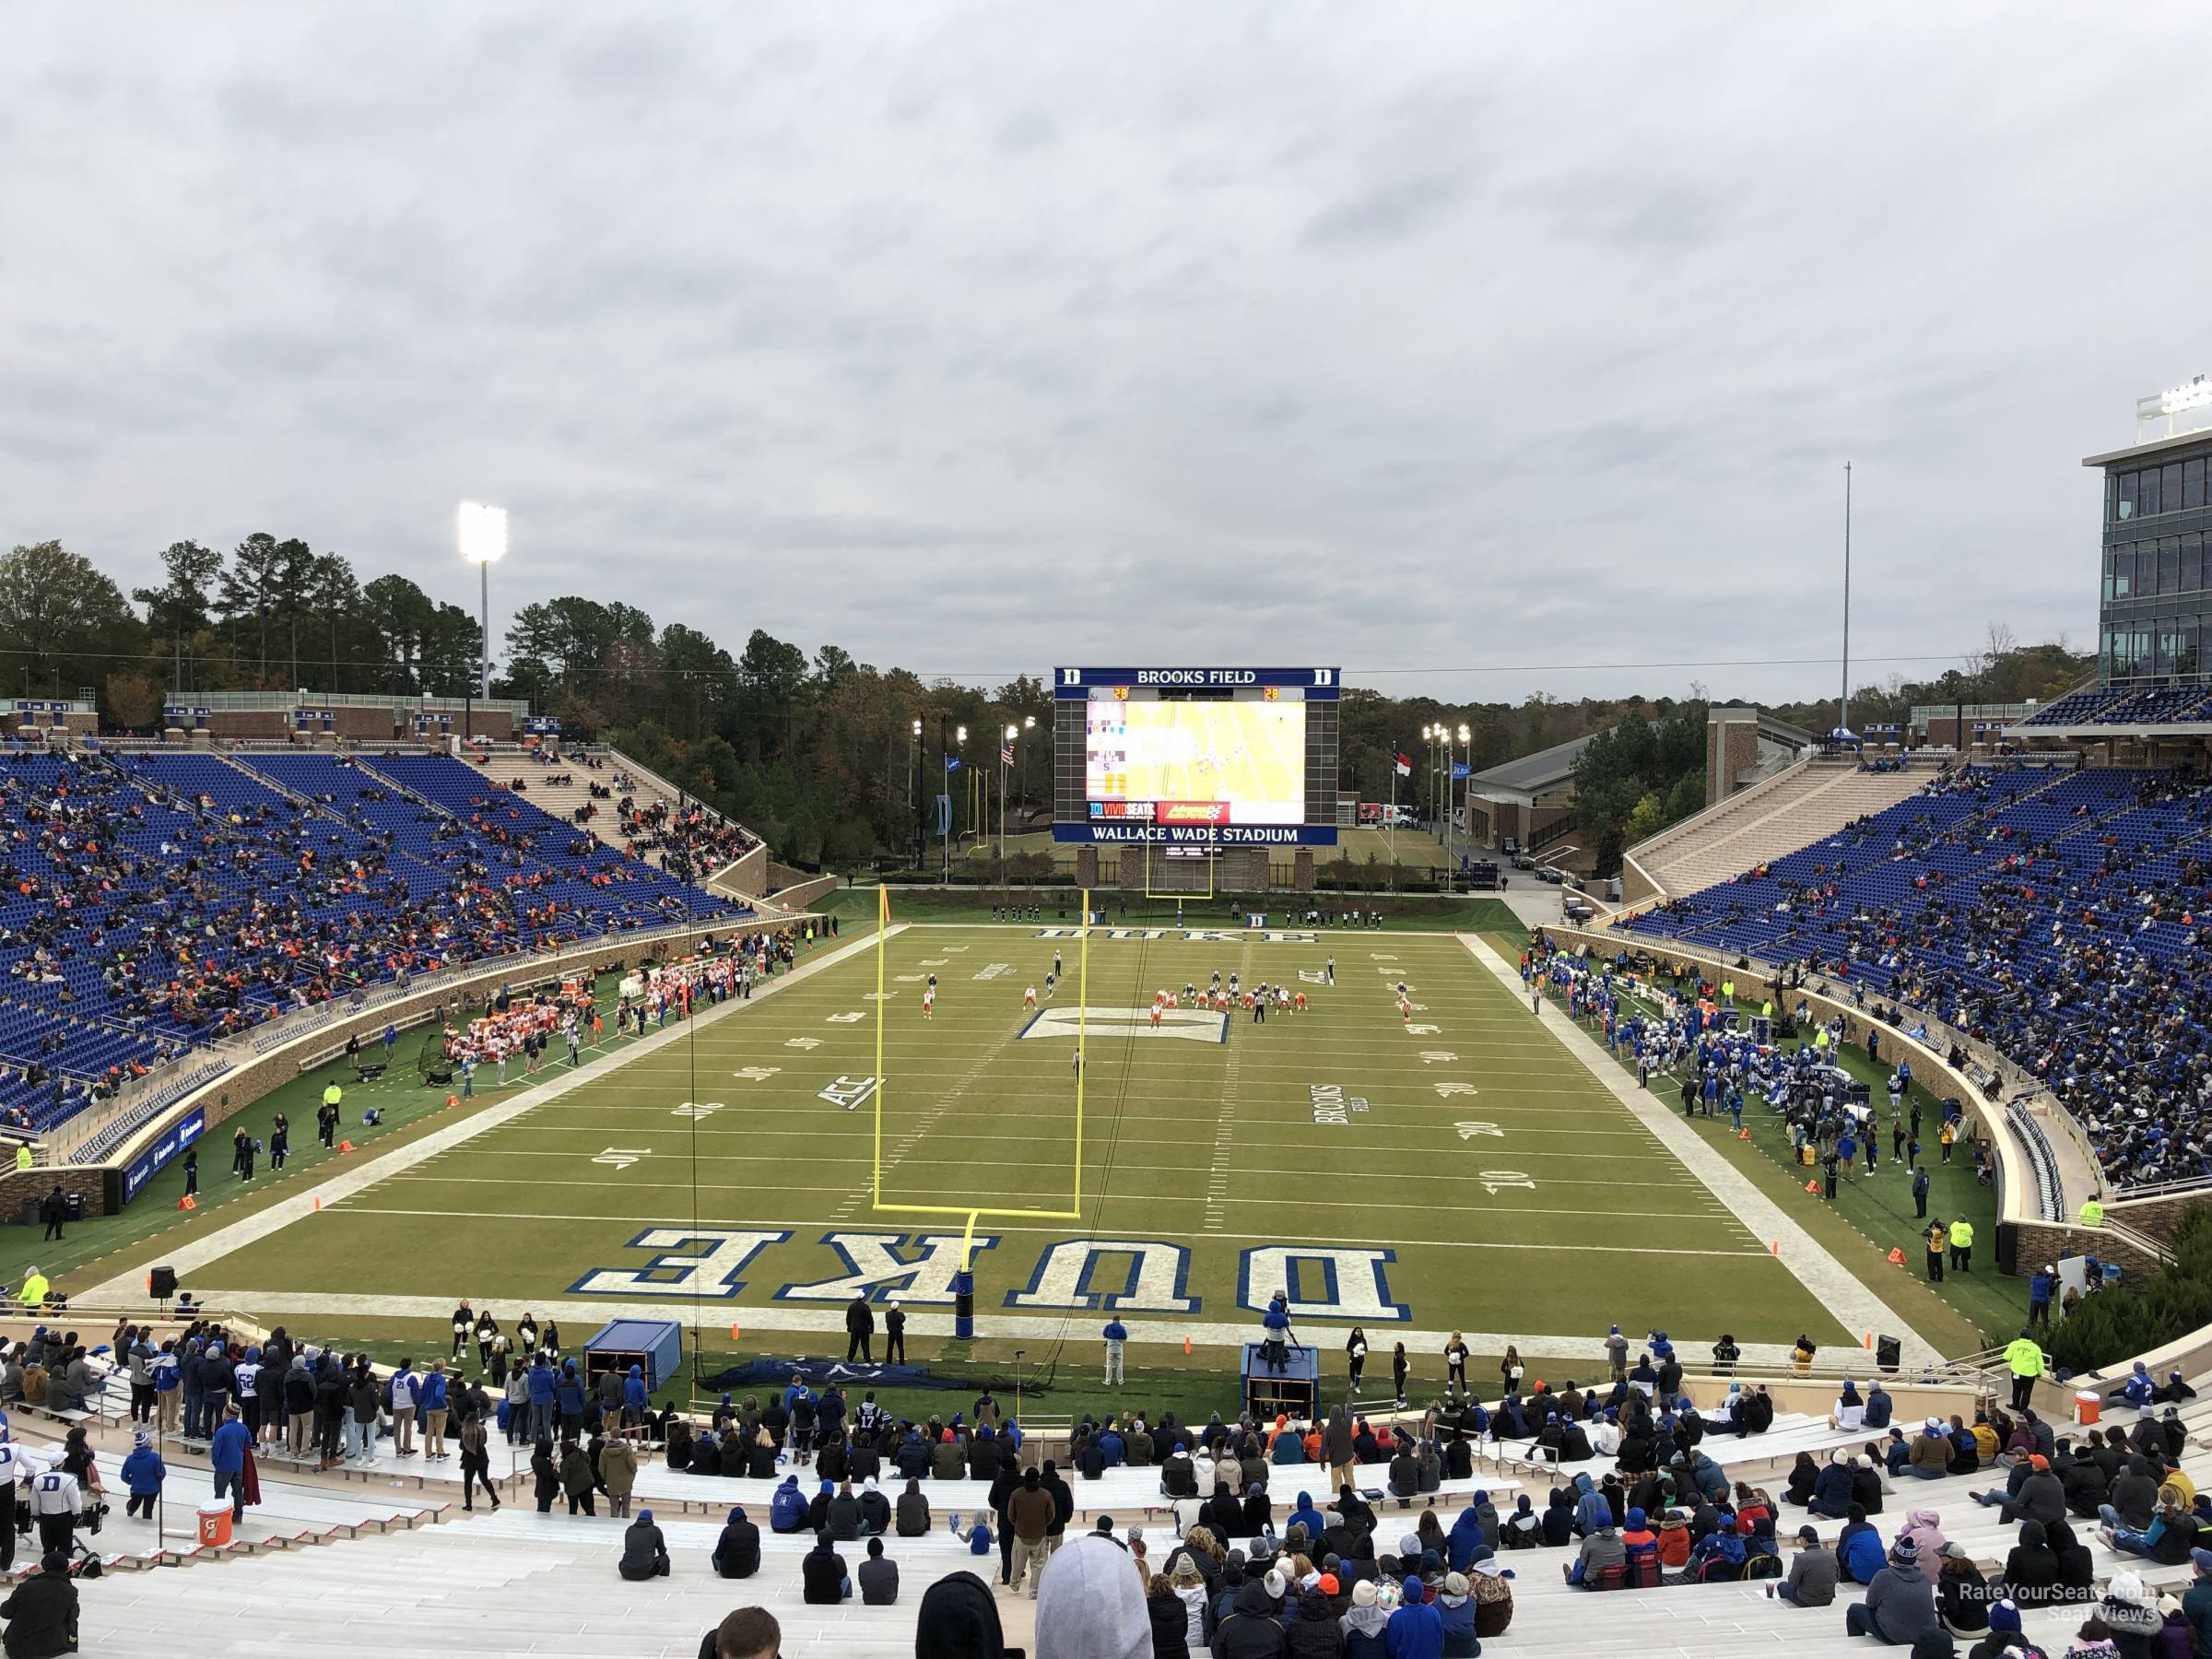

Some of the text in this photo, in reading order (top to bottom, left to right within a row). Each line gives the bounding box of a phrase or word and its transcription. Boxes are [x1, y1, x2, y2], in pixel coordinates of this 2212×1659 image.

[1137, 671, 1256, 683] BROOKS FIELD
[1113, 688, 1127, 699] 28
[1265, 688, 1278, 700] 28
[1093, 828, 1298, 842] WALLACE WADE STADIUM
[816, 1075, 877, 1106] ACC
[1434, 1082, 1478, 1095] 30
[671, 1102, 725, 1115] 20
[1310, 1085, 1349, 1124] BROOKS
[1453, 1121, 1505, 1137] 20
[591, 1147, 653, 1164] 10
[1479, 1171, 1536, 1189] 10
[566, 1227, 1413, 1323] DUKE
[239, 1373, 254, 1391] 52
[2145, 1384, 2153, 1397] 2
[861, 1415, 875, 1428] 17
[41, 1476, 60, 1491] D
